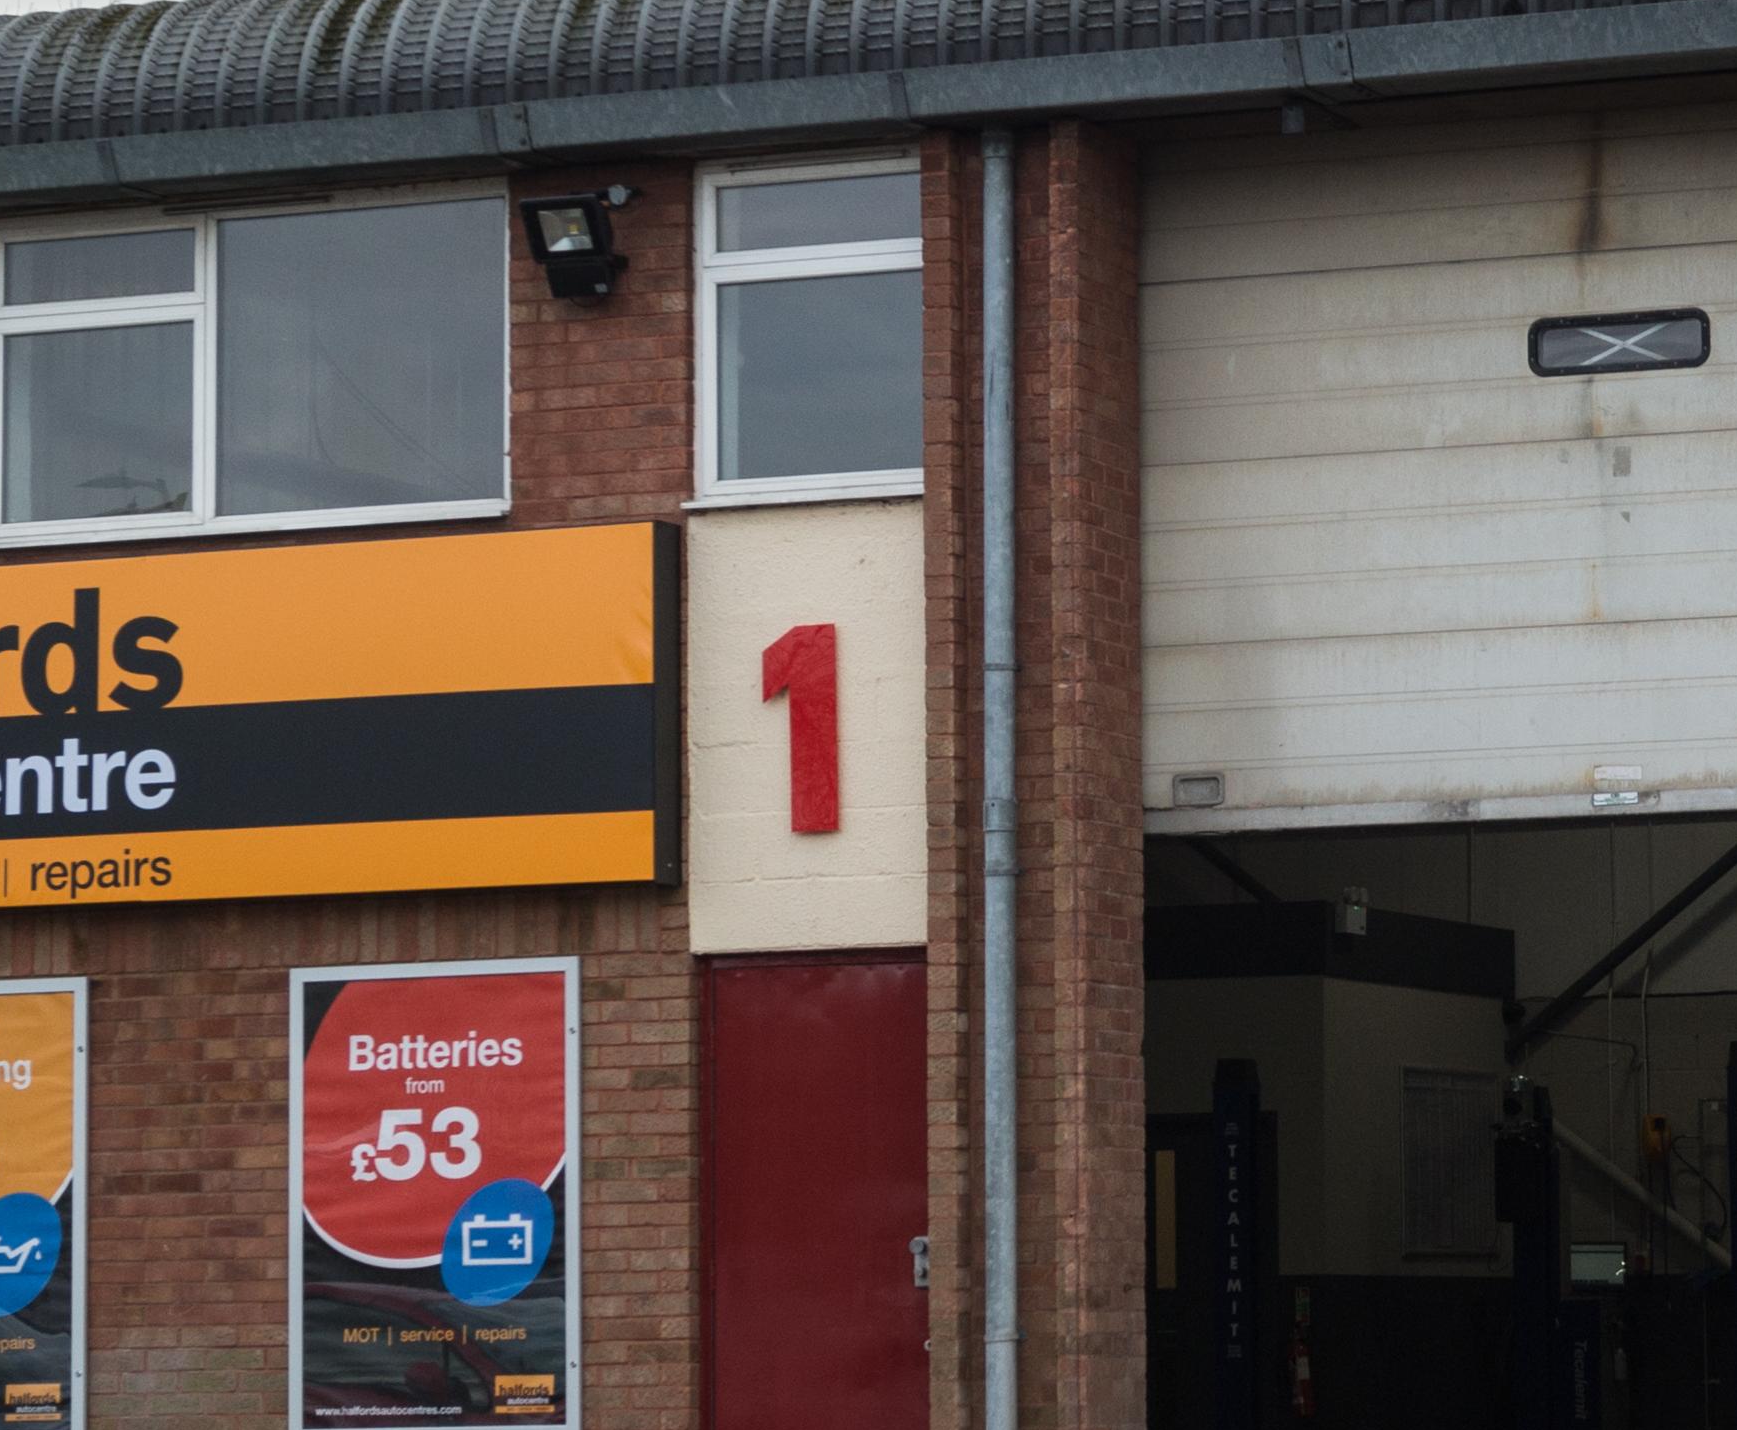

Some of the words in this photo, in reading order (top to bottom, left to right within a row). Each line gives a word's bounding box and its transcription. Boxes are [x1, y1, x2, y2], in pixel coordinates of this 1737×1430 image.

[762, 623, 839, 832] 1
[30, 848, 173, 900] repairs
[348, 1030, 523, 1071] Batteries
[405, 1077, 445, 1094] from
[350, 1106, 482, 1182] £53
[1226, 1143, 1242, 1338] TECALEMIT
[343, 1327, 380, 1343] MOT
[399, 1326, 455, 1343] service
[474, 1325, 527, 1344] repairs
[499, 1382, 550, 1396] halfords
[315, 1405, 463, 1416] www.halfordsautocentres.com
